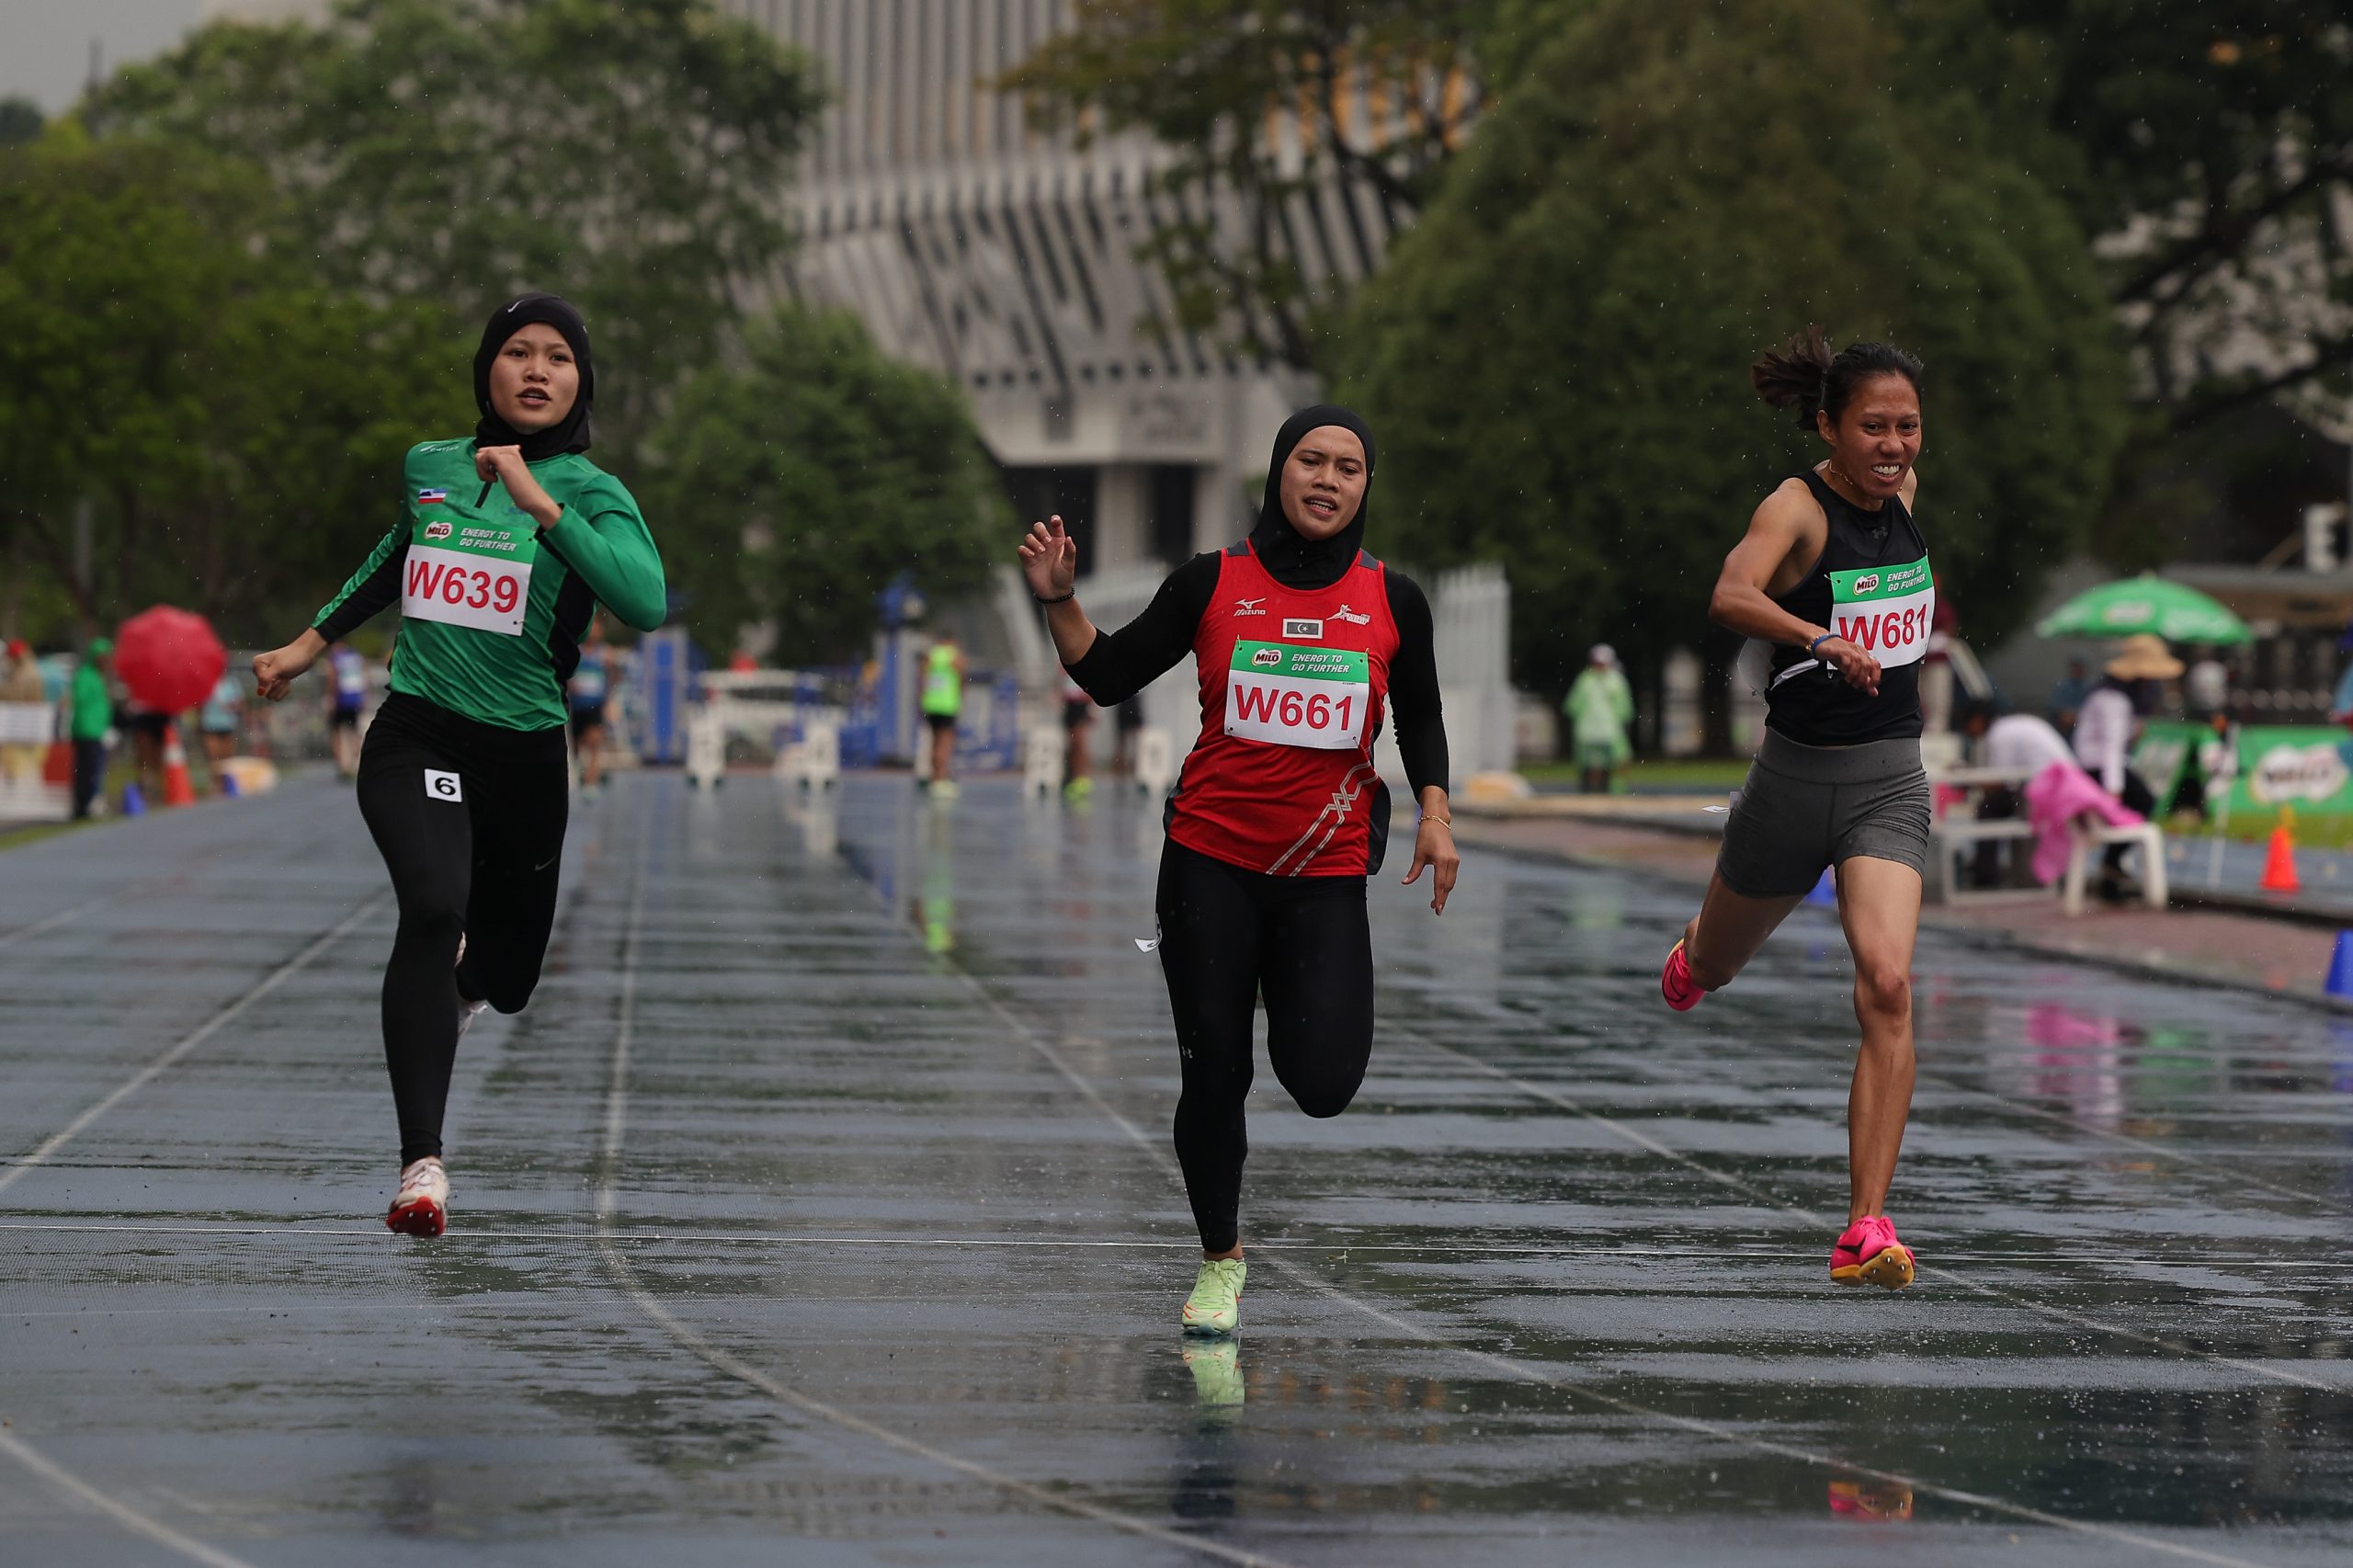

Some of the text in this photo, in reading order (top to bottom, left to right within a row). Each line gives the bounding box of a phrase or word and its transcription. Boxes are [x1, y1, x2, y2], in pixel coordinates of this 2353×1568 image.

[426, 526, 449, 536] MILO
[460, 528, 511, 540] ENERGY TO
[460, 538, 517, 551] GO FURTHER
[1887, 570, 1915, 582] ENERGY
[1915, 565, 1922, 574] TO
[408, 559, 518, 613] W639
[1857, 579, 1877, 590] MILO
[1888, 574, 1926, 592] GO FURTHER
[1838, 603, 1927, 650] W681
[1256, 653, 1279, 663] MILO
[1291, 653, 1343, 663] ENERGY TO
[1291, 664, 1350, 673] GO FURTHER
[1234, 685, 1352, 731] W661
[435, 777, 456, 796] 6
